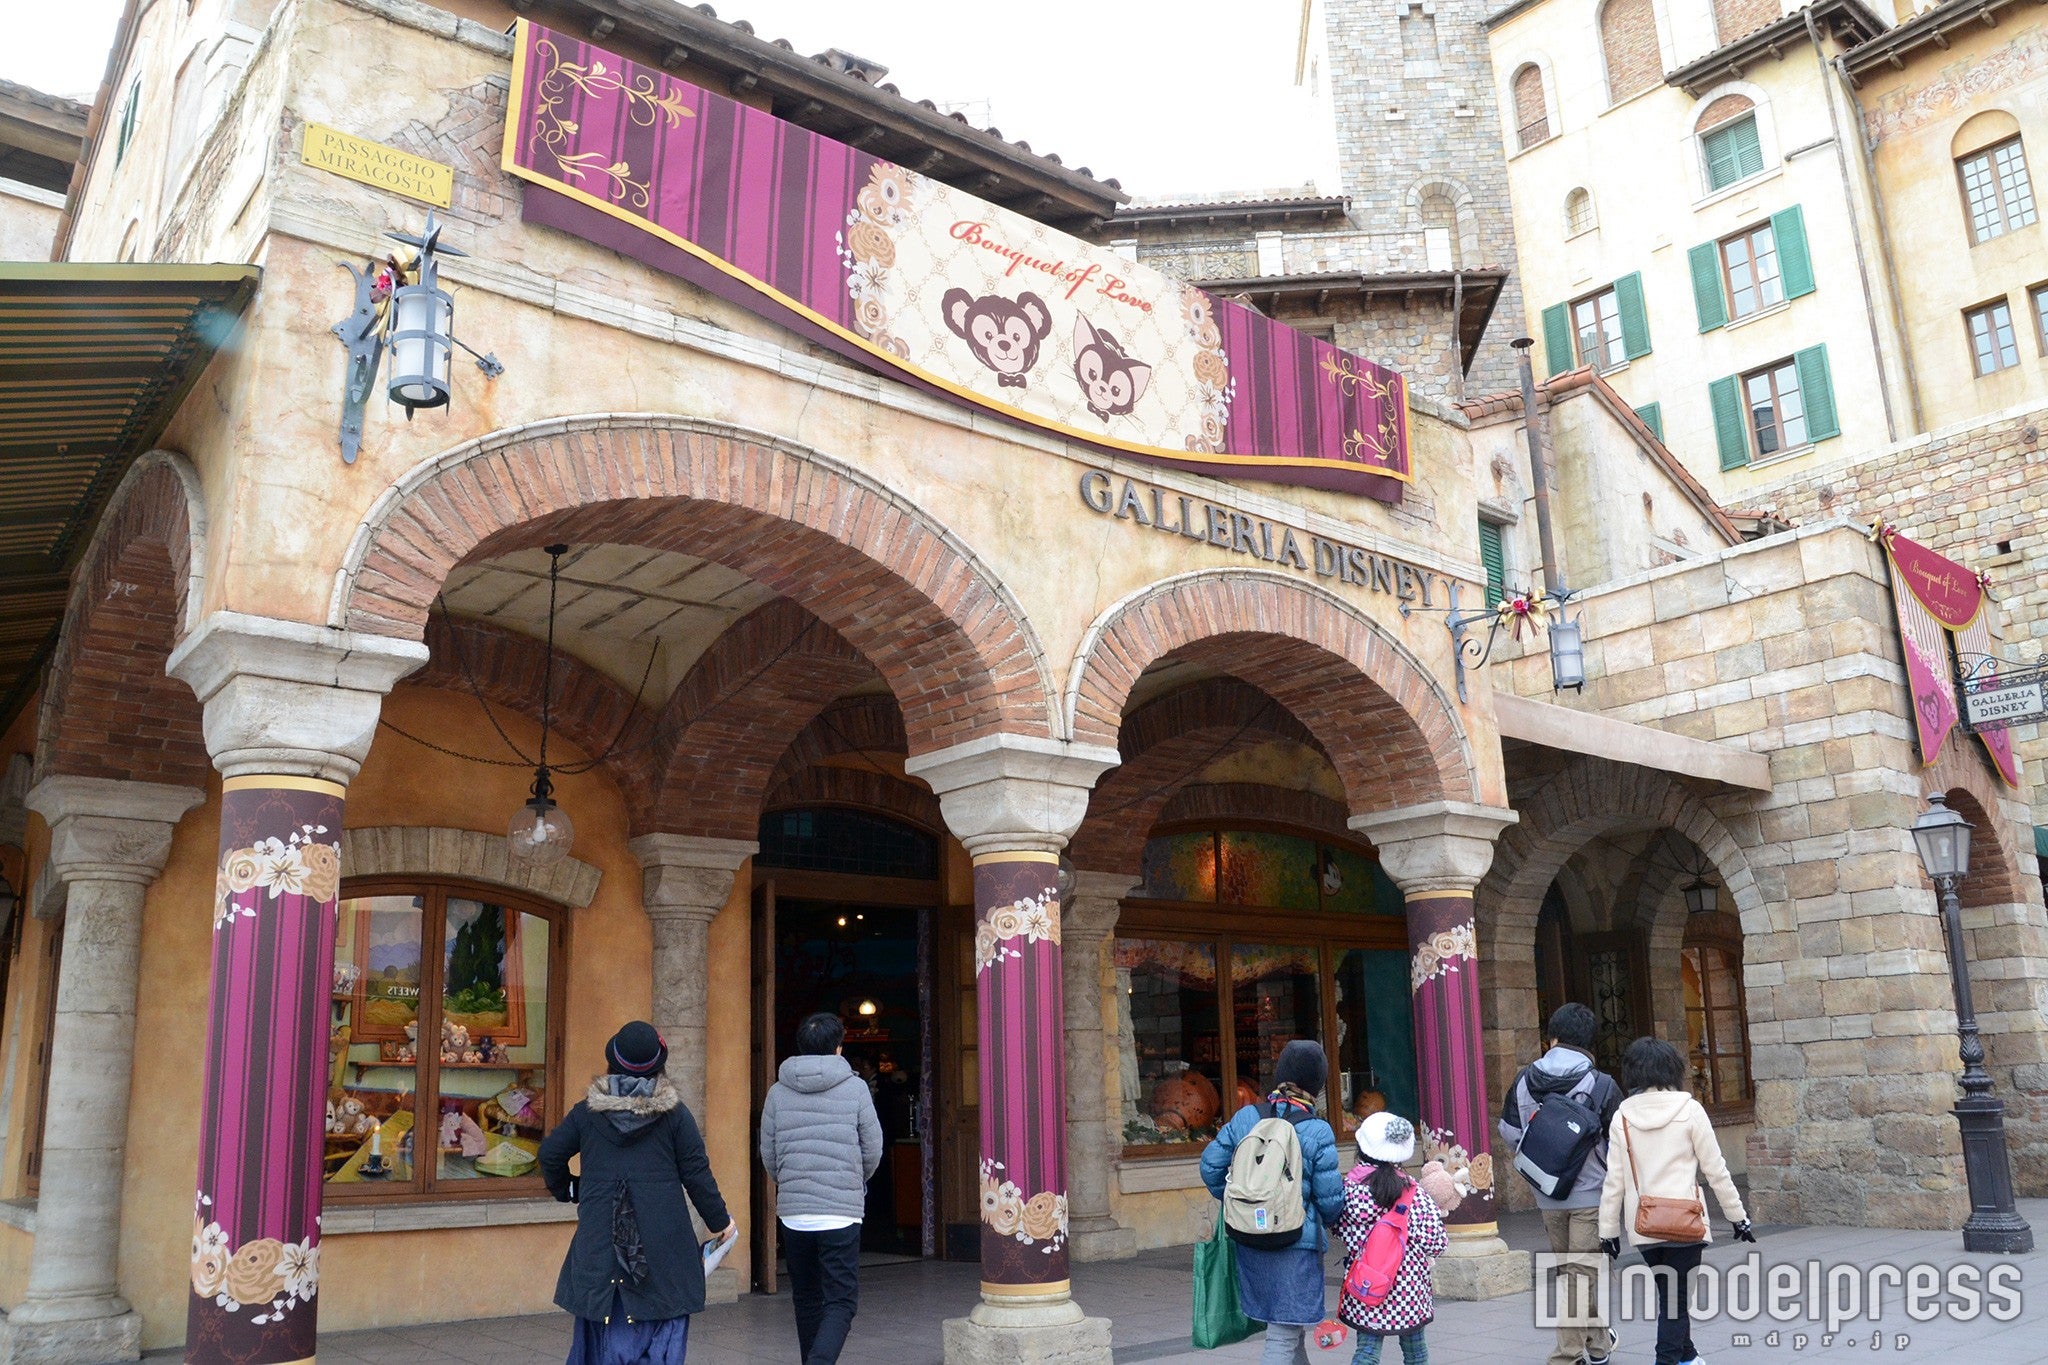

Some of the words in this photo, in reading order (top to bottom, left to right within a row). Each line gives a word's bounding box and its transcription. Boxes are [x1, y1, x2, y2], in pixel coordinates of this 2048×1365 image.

[318, 149, 436, 197] MIRACOSTA
[324, 134, 435, 179] PASSAGGIO
[949, 220, 1063, 277] Bouquet
[1065, 264, 1101, 300] of
[1096, 273, 1153, 314] Love
[1080, 469, 1308, 570] GALLERIA
[1311, 537, 1437, 606] DISNEY
[1911, 560, 1941, 590] Bouquet
[1941, 572, 1951, 597] of
[1972, 690, 2035, 706] GALLERIA
[1980, 701, 2029, 717] DISNEY
